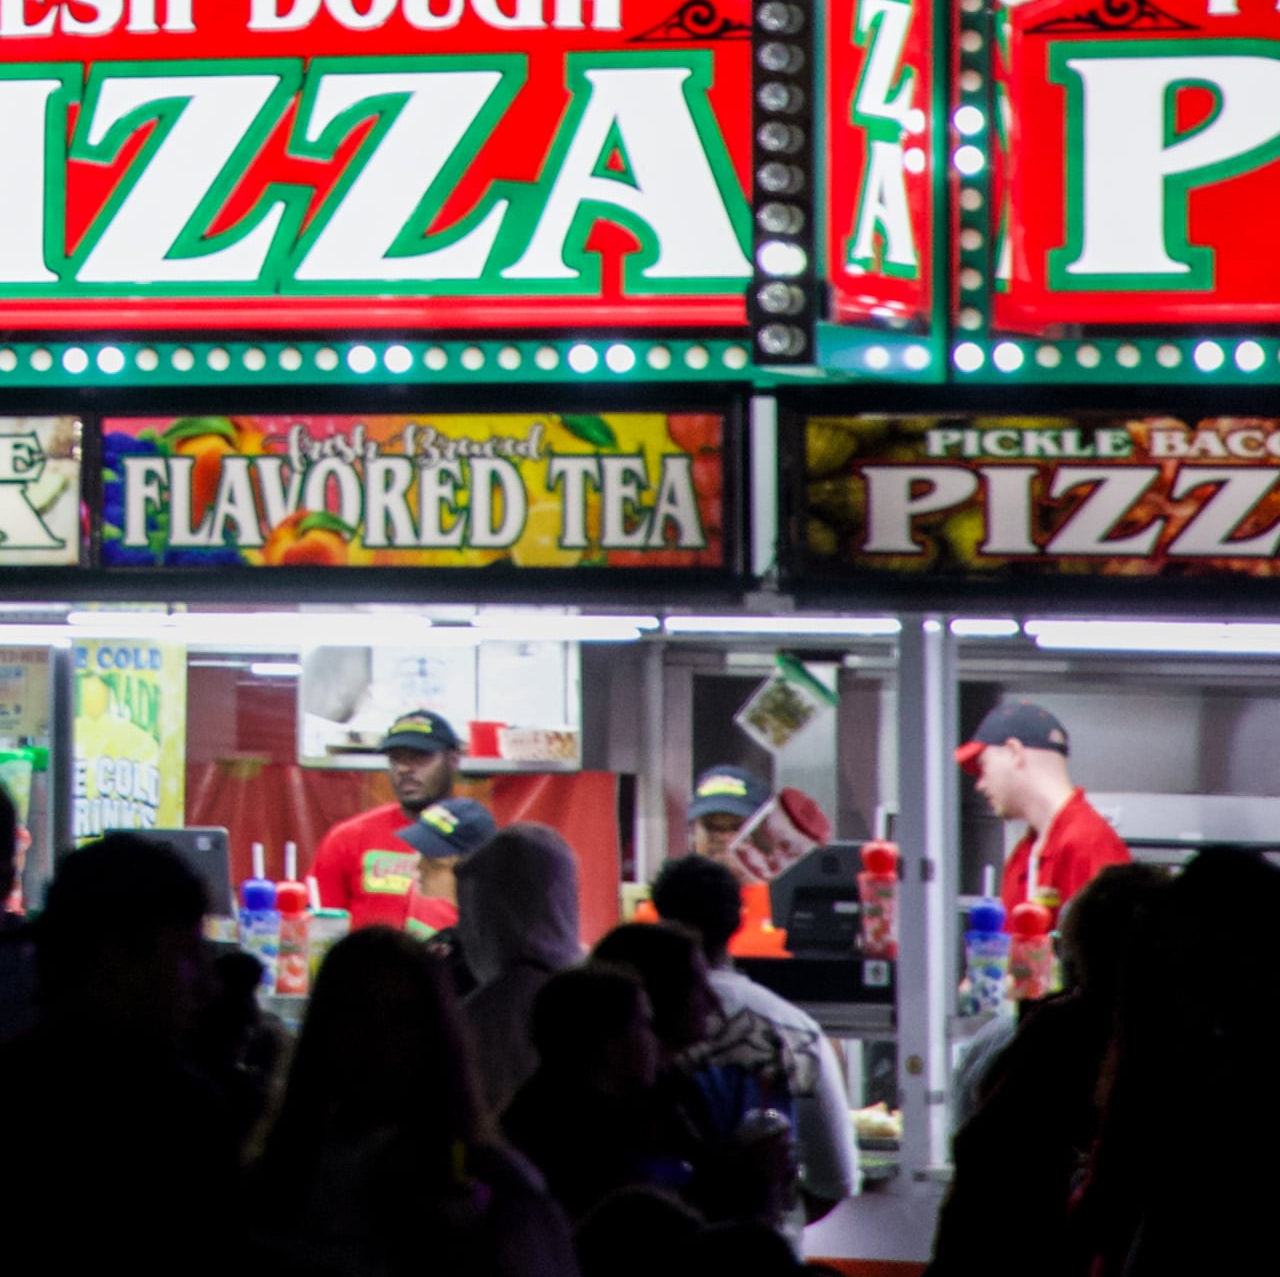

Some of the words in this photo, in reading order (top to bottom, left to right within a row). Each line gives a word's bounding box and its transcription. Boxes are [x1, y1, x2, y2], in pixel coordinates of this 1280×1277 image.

[926, 429, 1132, 458] PICKLE
[121, 453, 530, 550] FLAVORED
[548, 453, 708, 550] TEA
[96, 647, 162, 670] COLD
